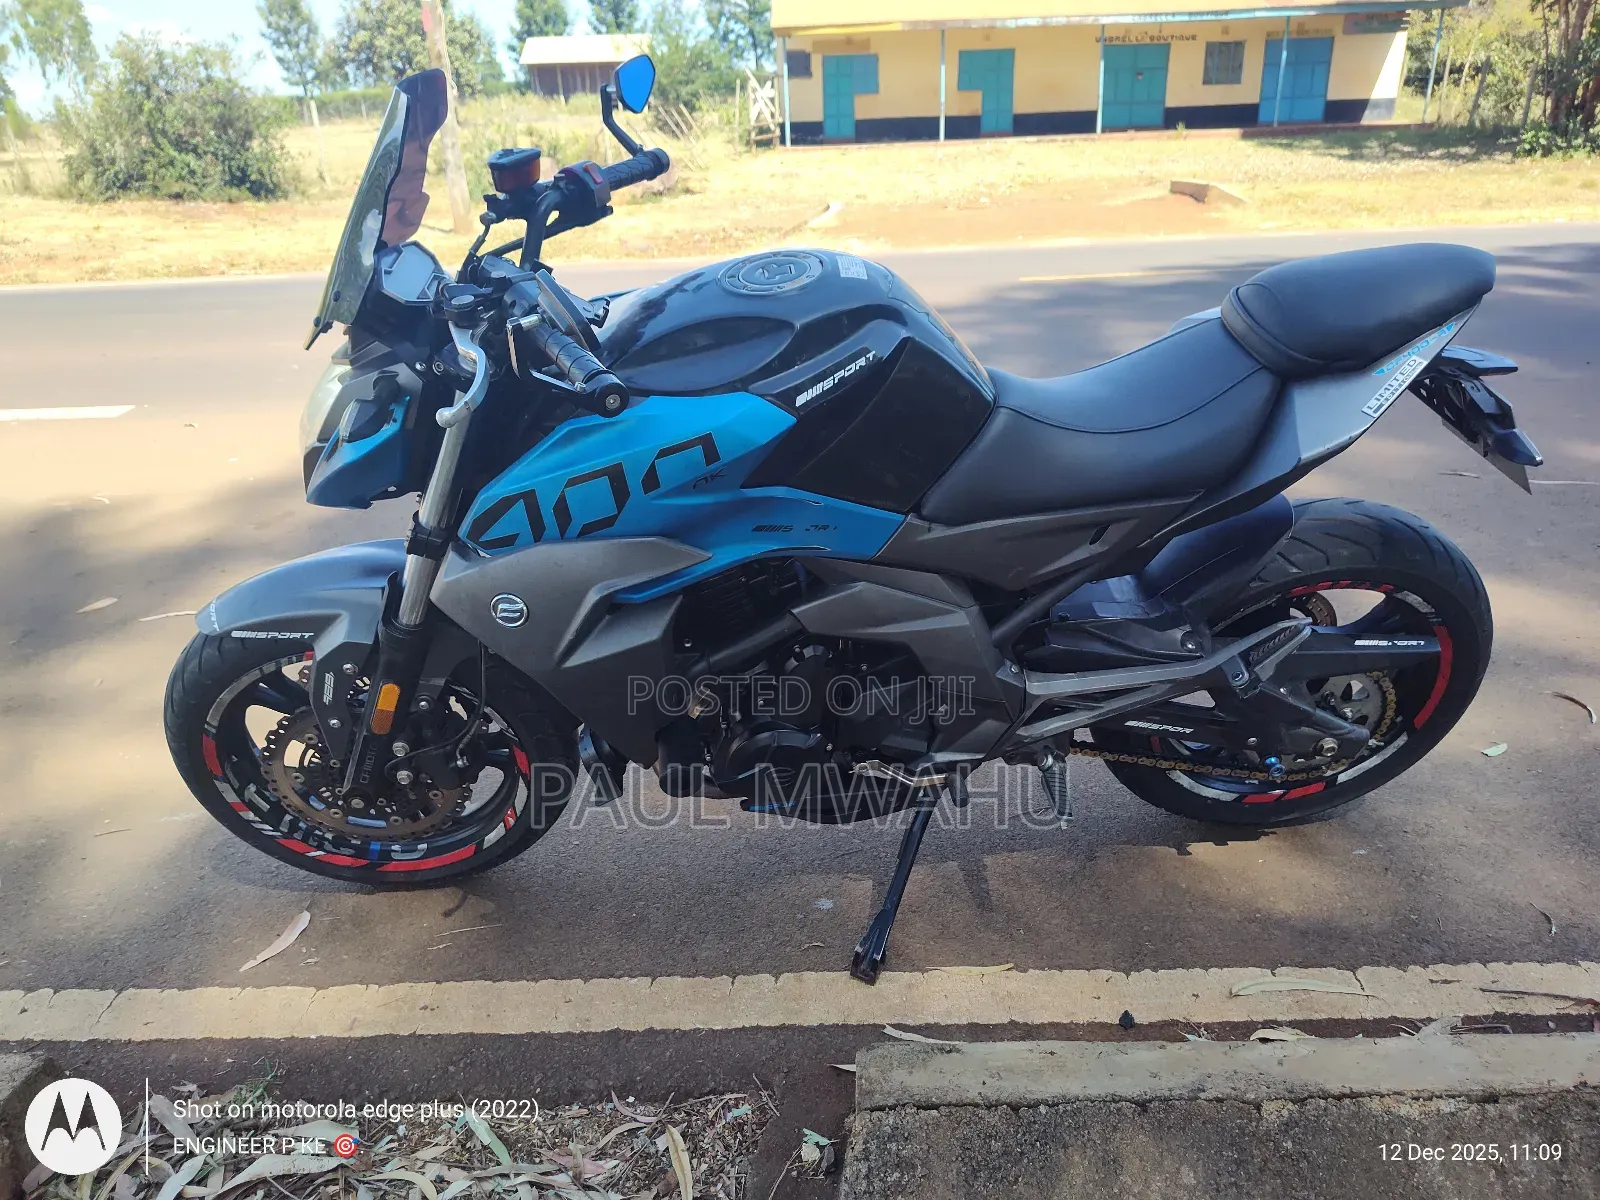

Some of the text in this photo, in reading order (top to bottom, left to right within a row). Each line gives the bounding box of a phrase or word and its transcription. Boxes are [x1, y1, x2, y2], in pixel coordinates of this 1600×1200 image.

[822, 350, 876, 391] SPORT
[1366, 358, 1418, 410] LIMITED
[255, 631, 315, 639] SPORT
